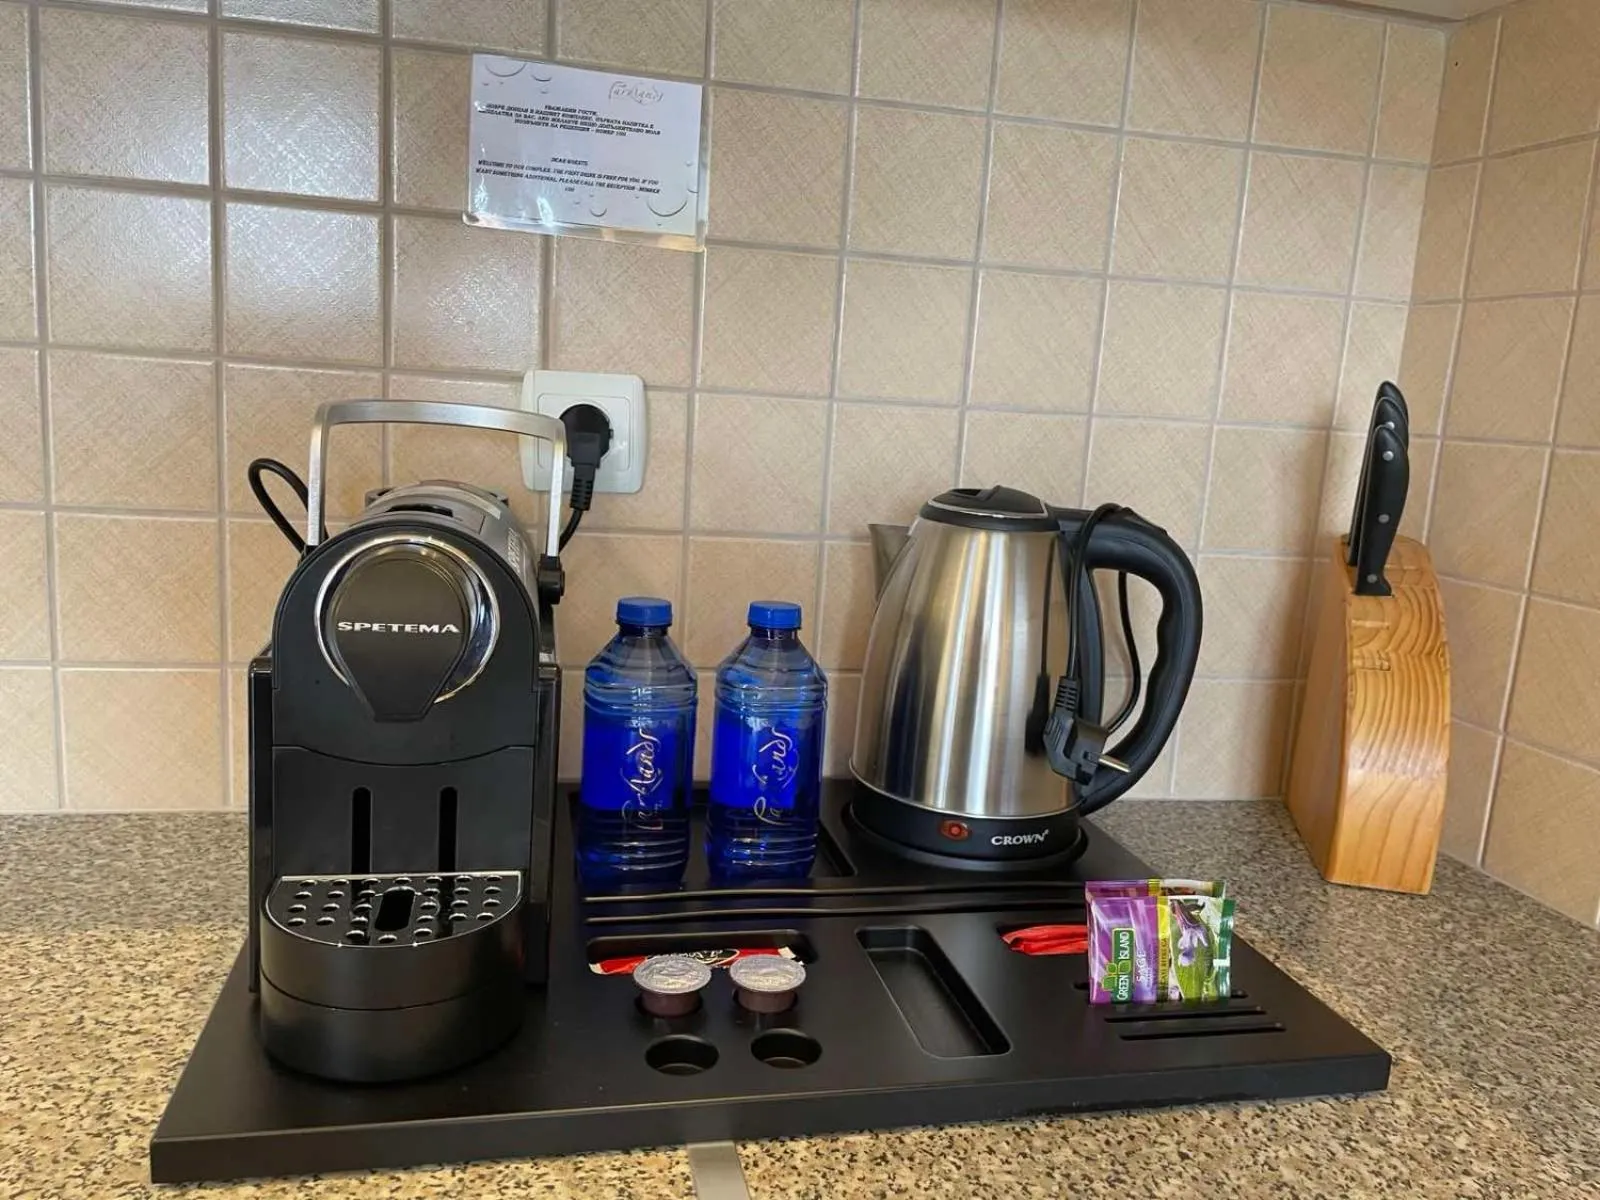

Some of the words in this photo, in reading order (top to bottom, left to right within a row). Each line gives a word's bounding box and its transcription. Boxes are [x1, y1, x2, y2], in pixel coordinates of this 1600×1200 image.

[478, 159, 504, 168] WELCOME
[493, 169, 524, 178] SOMETHING
[559, 177, 580, 185] PLEASE
[606, 182, 635, 191] RECEPTION
[337, 621, 460, 634] SPETEMA
[990, 833, 1045, 846] CROWN
[1118, 931, 1130, 960] ISLAND
[1117, 974, 1129, 1000] GREEN
